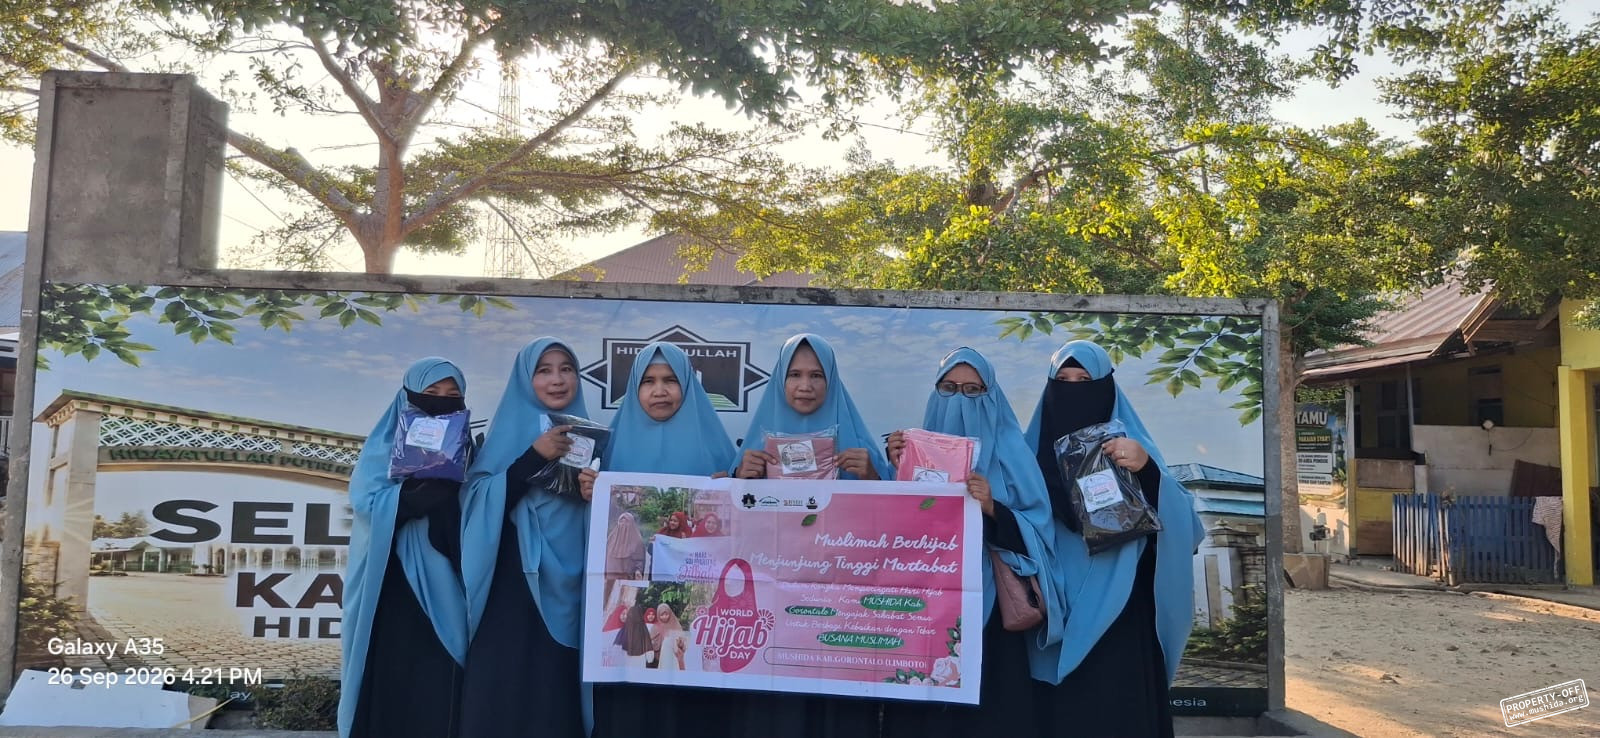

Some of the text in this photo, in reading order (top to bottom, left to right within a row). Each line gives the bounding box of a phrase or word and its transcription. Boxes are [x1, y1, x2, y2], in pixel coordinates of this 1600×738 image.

[109, 447, 275, 465] HIDAYATULLAH
[814, 532, 958, 554] Muslimah Berhijab
[750, 552, 959, 576] Menjunjung Tinggi Martabat
[863, 596, 902, 607] MUSHIDA
[720, 608, 754, 618] WORLD
[691, 614, 769, 658] Hijab
[818, 632, 902, 646] BUSANA MUSLIMAH
[730, 650, 751, 660] DAY
